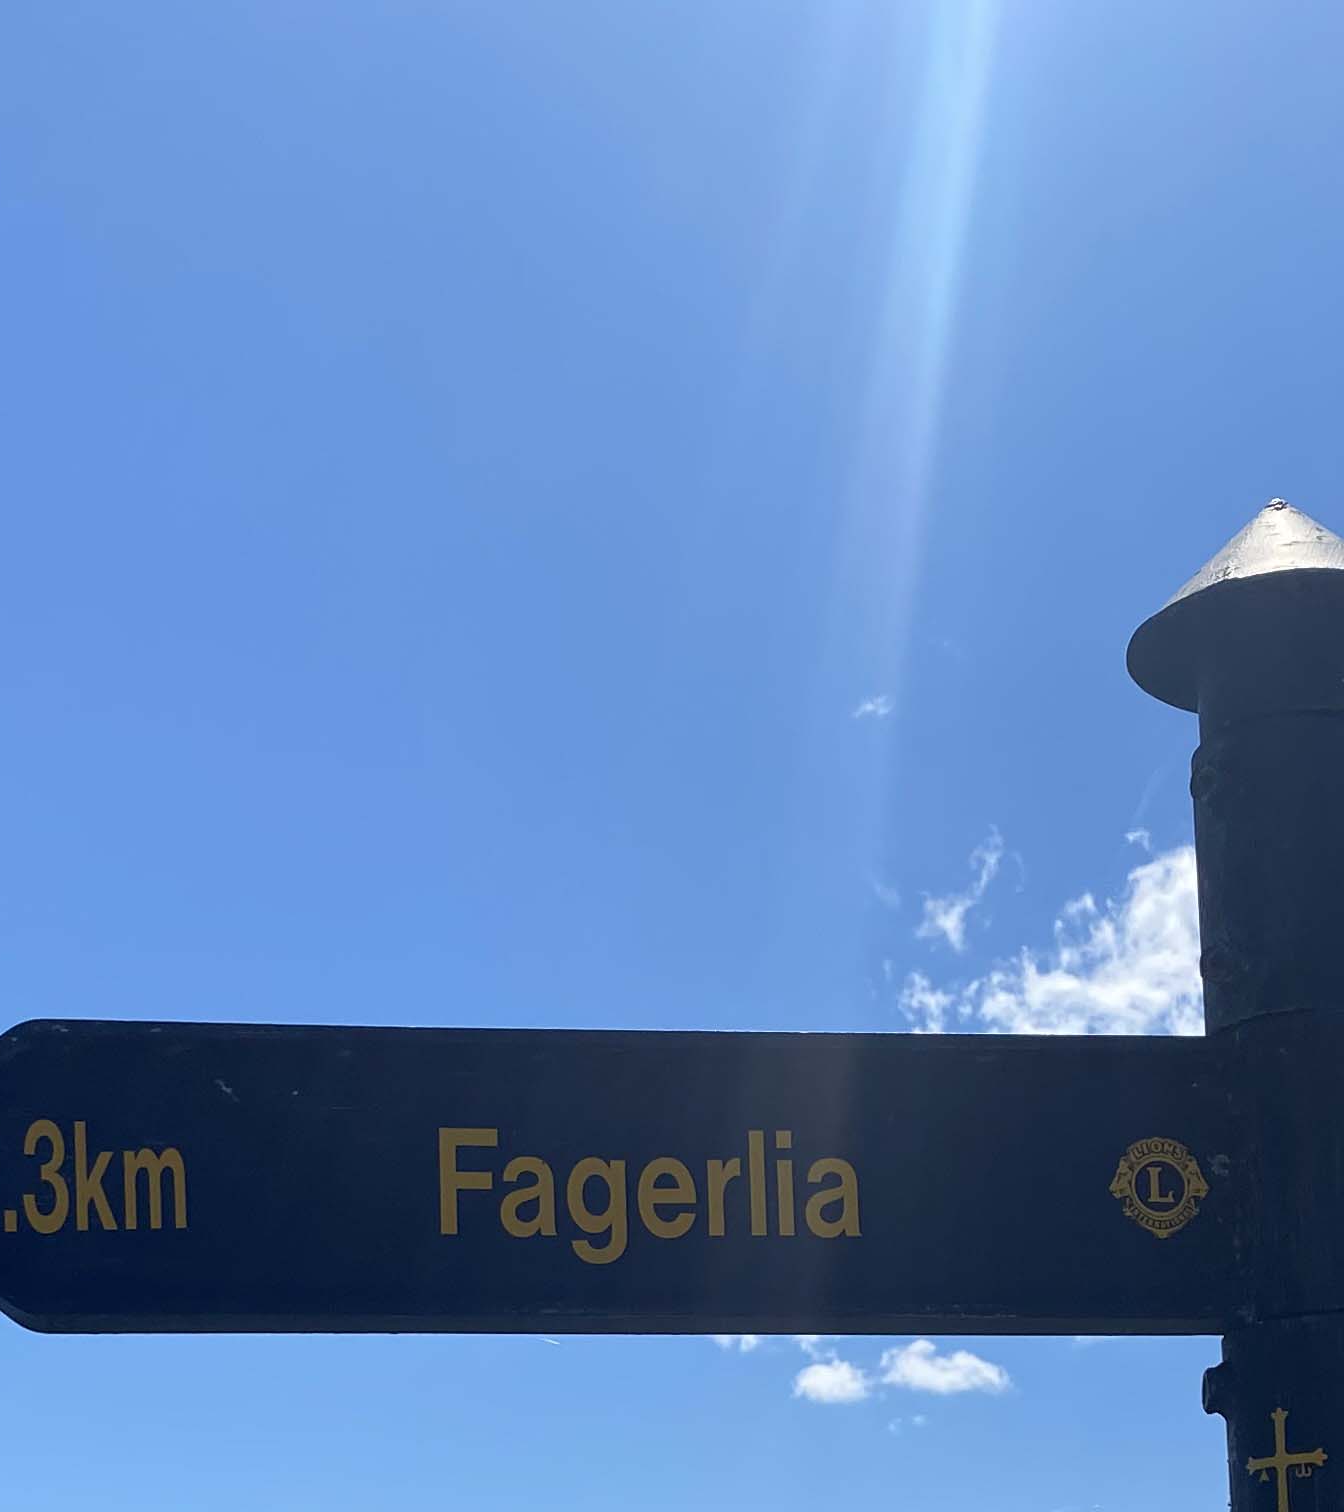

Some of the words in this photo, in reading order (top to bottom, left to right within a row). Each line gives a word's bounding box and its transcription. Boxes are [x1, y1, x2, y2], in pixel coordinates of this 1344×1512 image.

[1130, 1141, 1186, 1160] LIONS
[439, 1127, 861, 1264] Fagerlia
[1146, 1167, 1175, 1202] L
